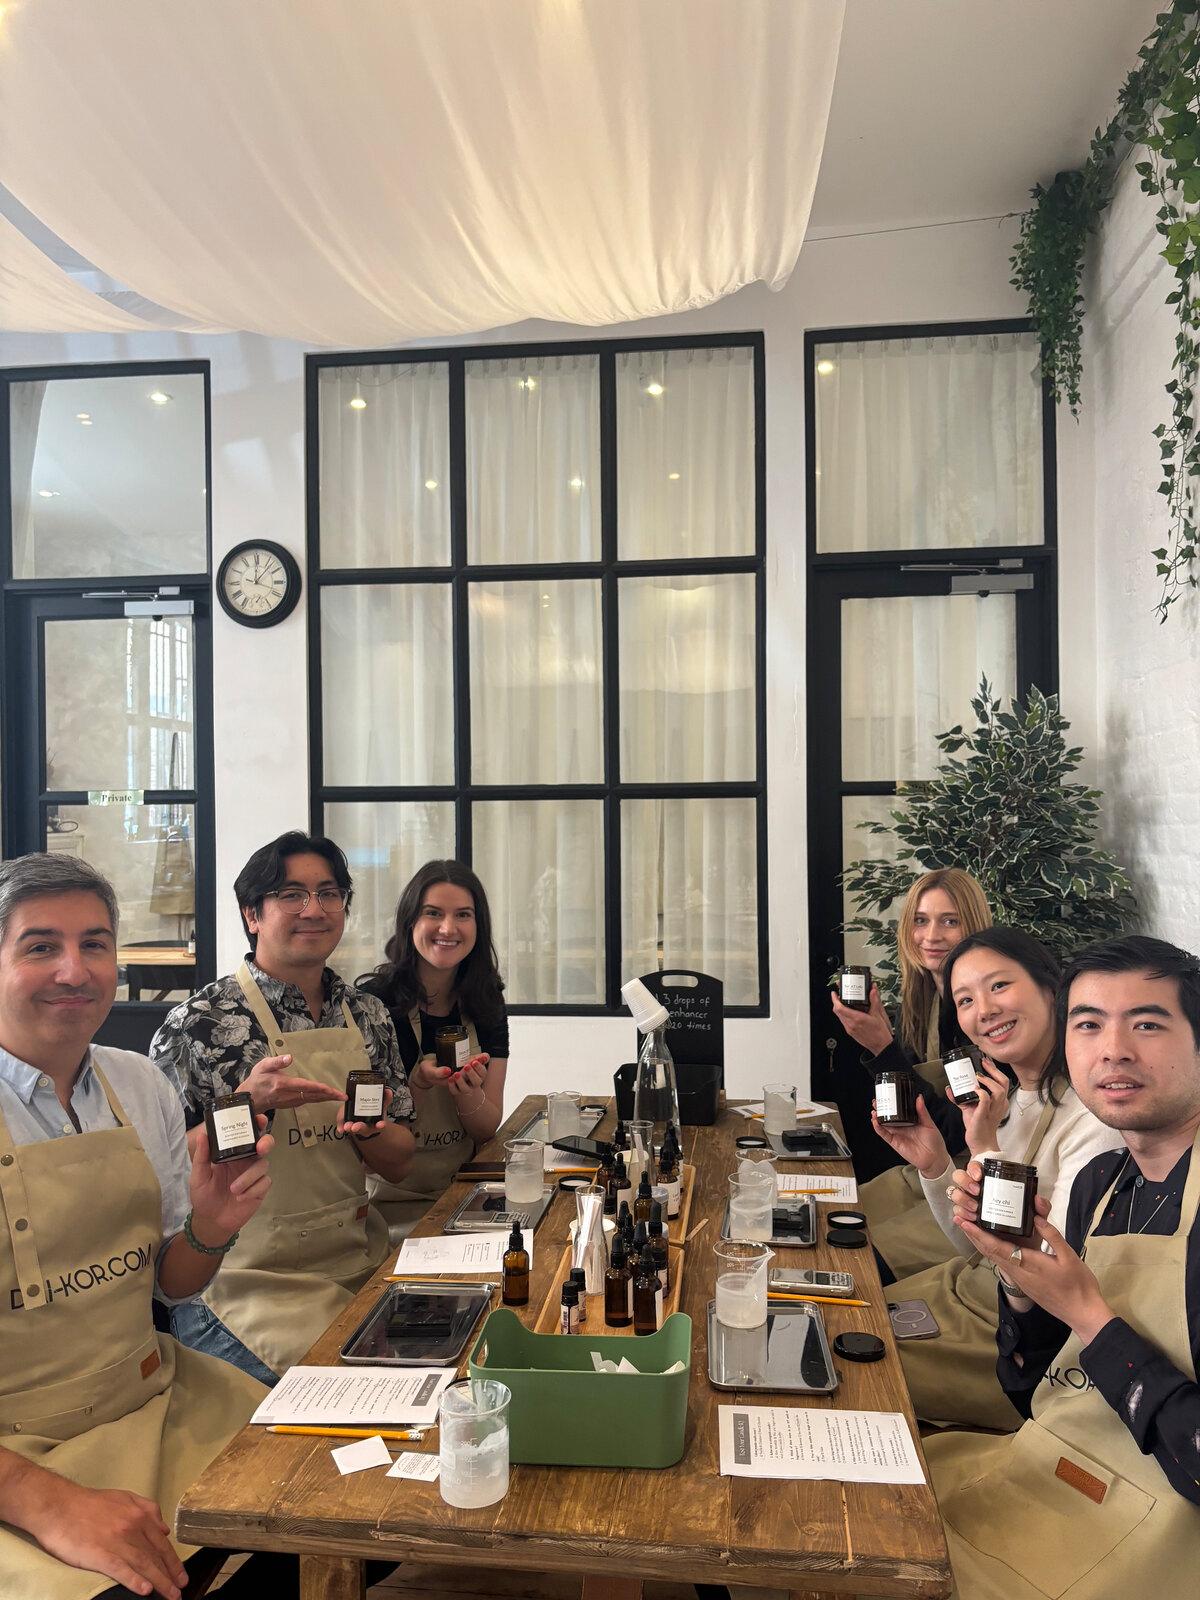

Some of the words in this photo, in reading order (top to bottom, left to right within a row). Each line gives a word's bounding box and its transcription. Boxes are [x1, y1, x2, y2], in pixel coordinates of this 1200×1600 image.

[102, 794, 132, 802] Private
[673, 994, 695, 1009] drops
[700, 996, 710, 1006] of
[687, 1021, 711, 1030] times
